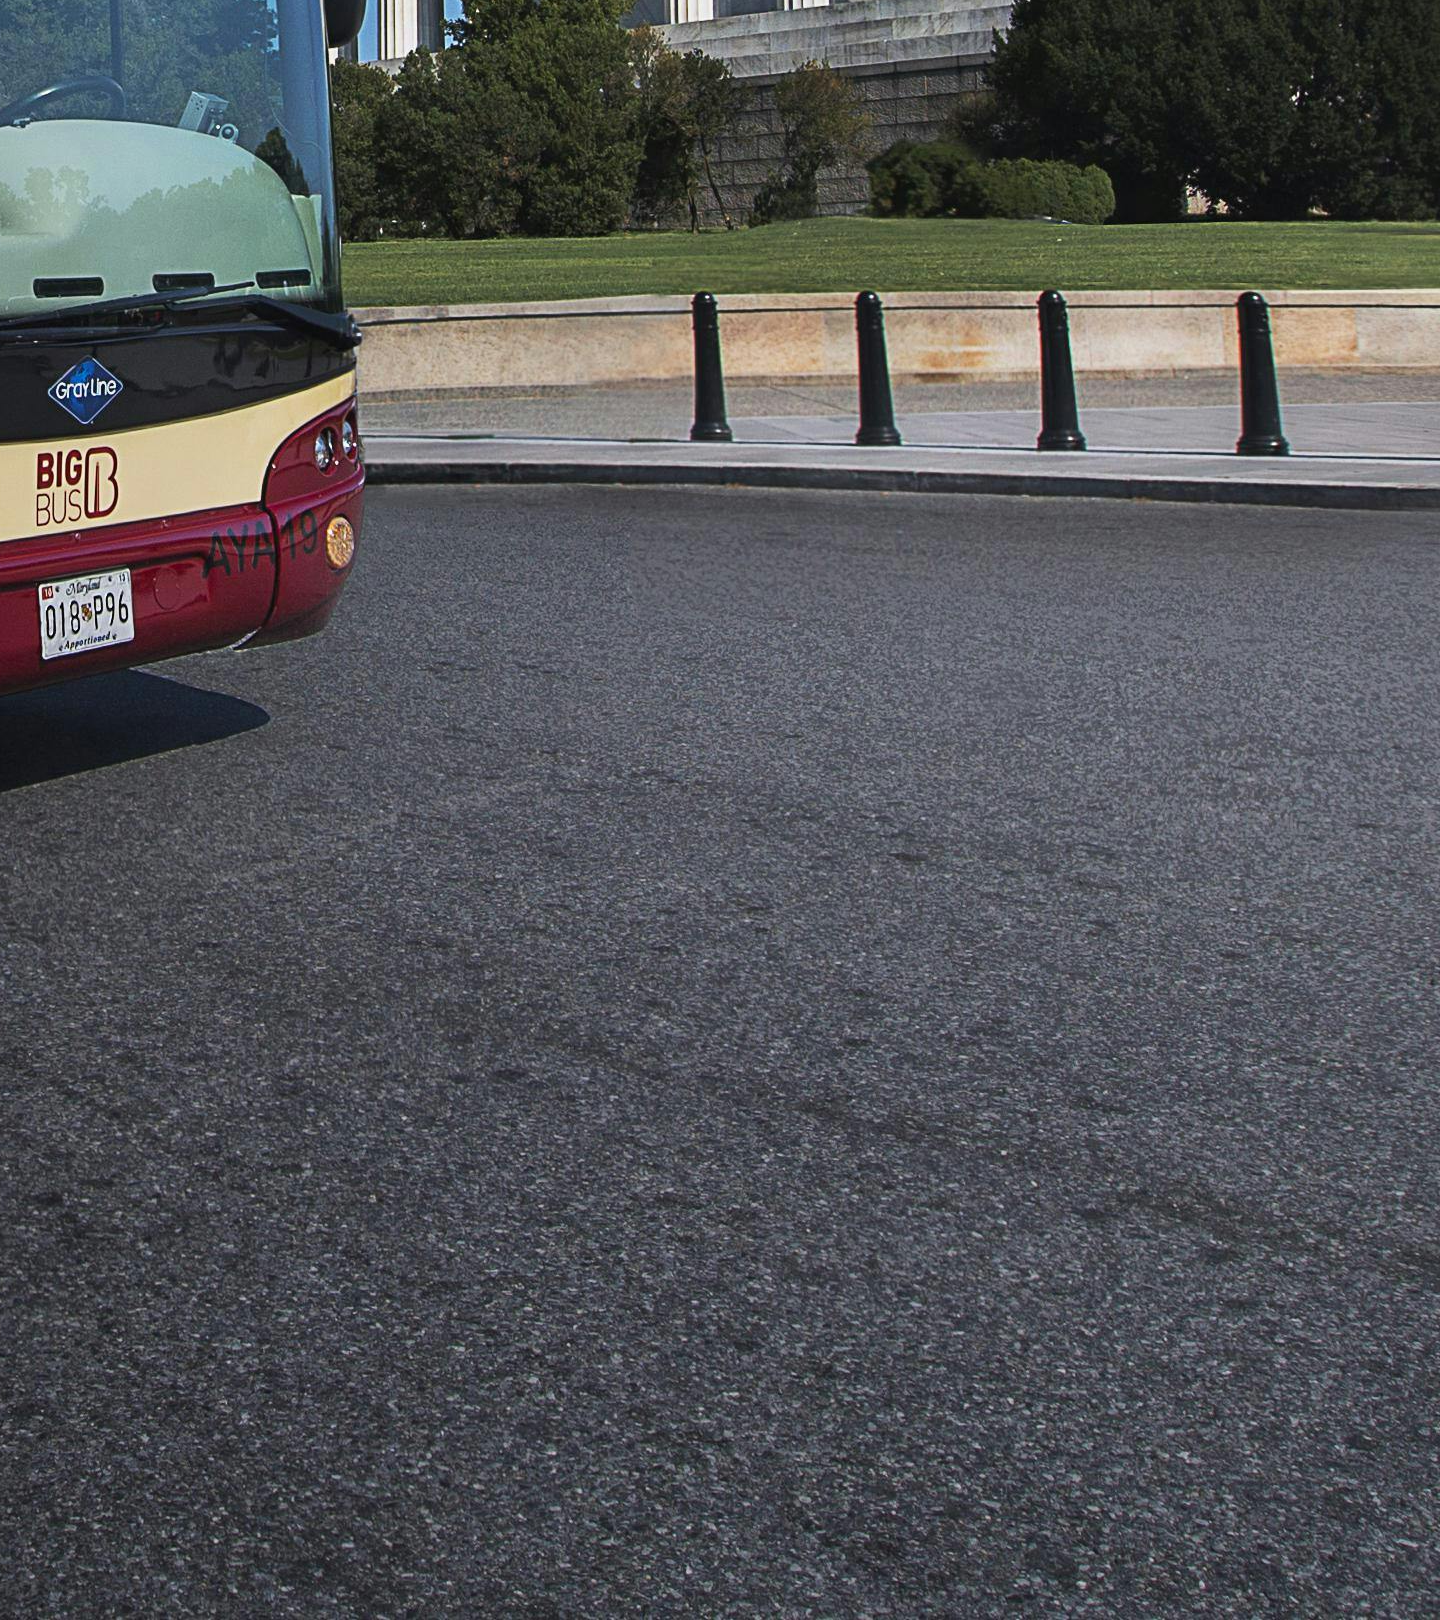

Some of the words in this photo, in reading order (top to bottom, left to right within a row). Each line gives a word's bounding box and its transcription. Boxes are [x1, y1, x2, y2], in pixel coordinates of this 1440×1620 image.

[55, 381, 90, 400] Gray
[90, 377, 117, 397] Line
[36, 449, 83, 490] BIG
[36, 488, 83, 527] BUS
[202, 520, 276, 579] AYA
[280, 509, 319, 560] 19
[64, 631, 111, 650] Apportioned
